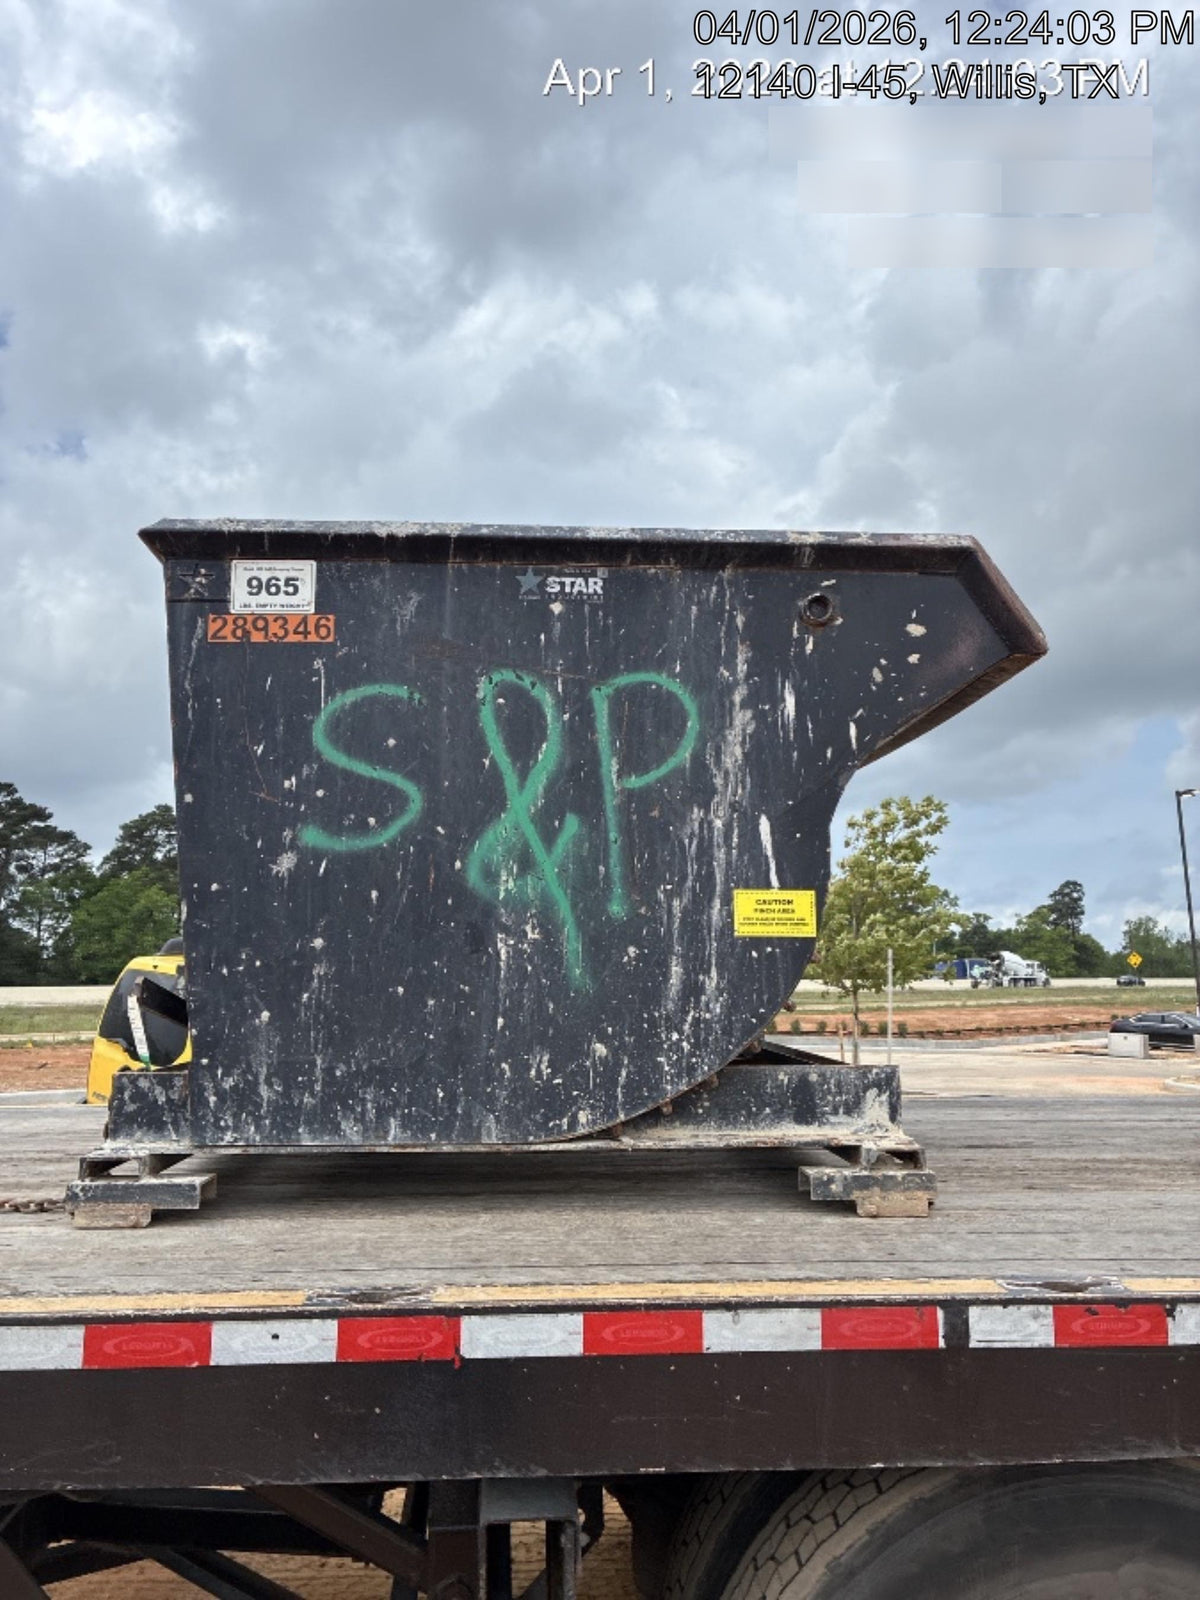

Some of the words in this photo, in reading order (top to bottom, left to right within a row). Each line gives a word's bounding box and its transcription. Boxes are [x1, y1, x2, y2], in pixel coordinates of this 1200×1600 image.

[246, 576, 299, 596] 965
[545, 576, 603, 594] STAR
[210, 616, 331, 640] 289346
